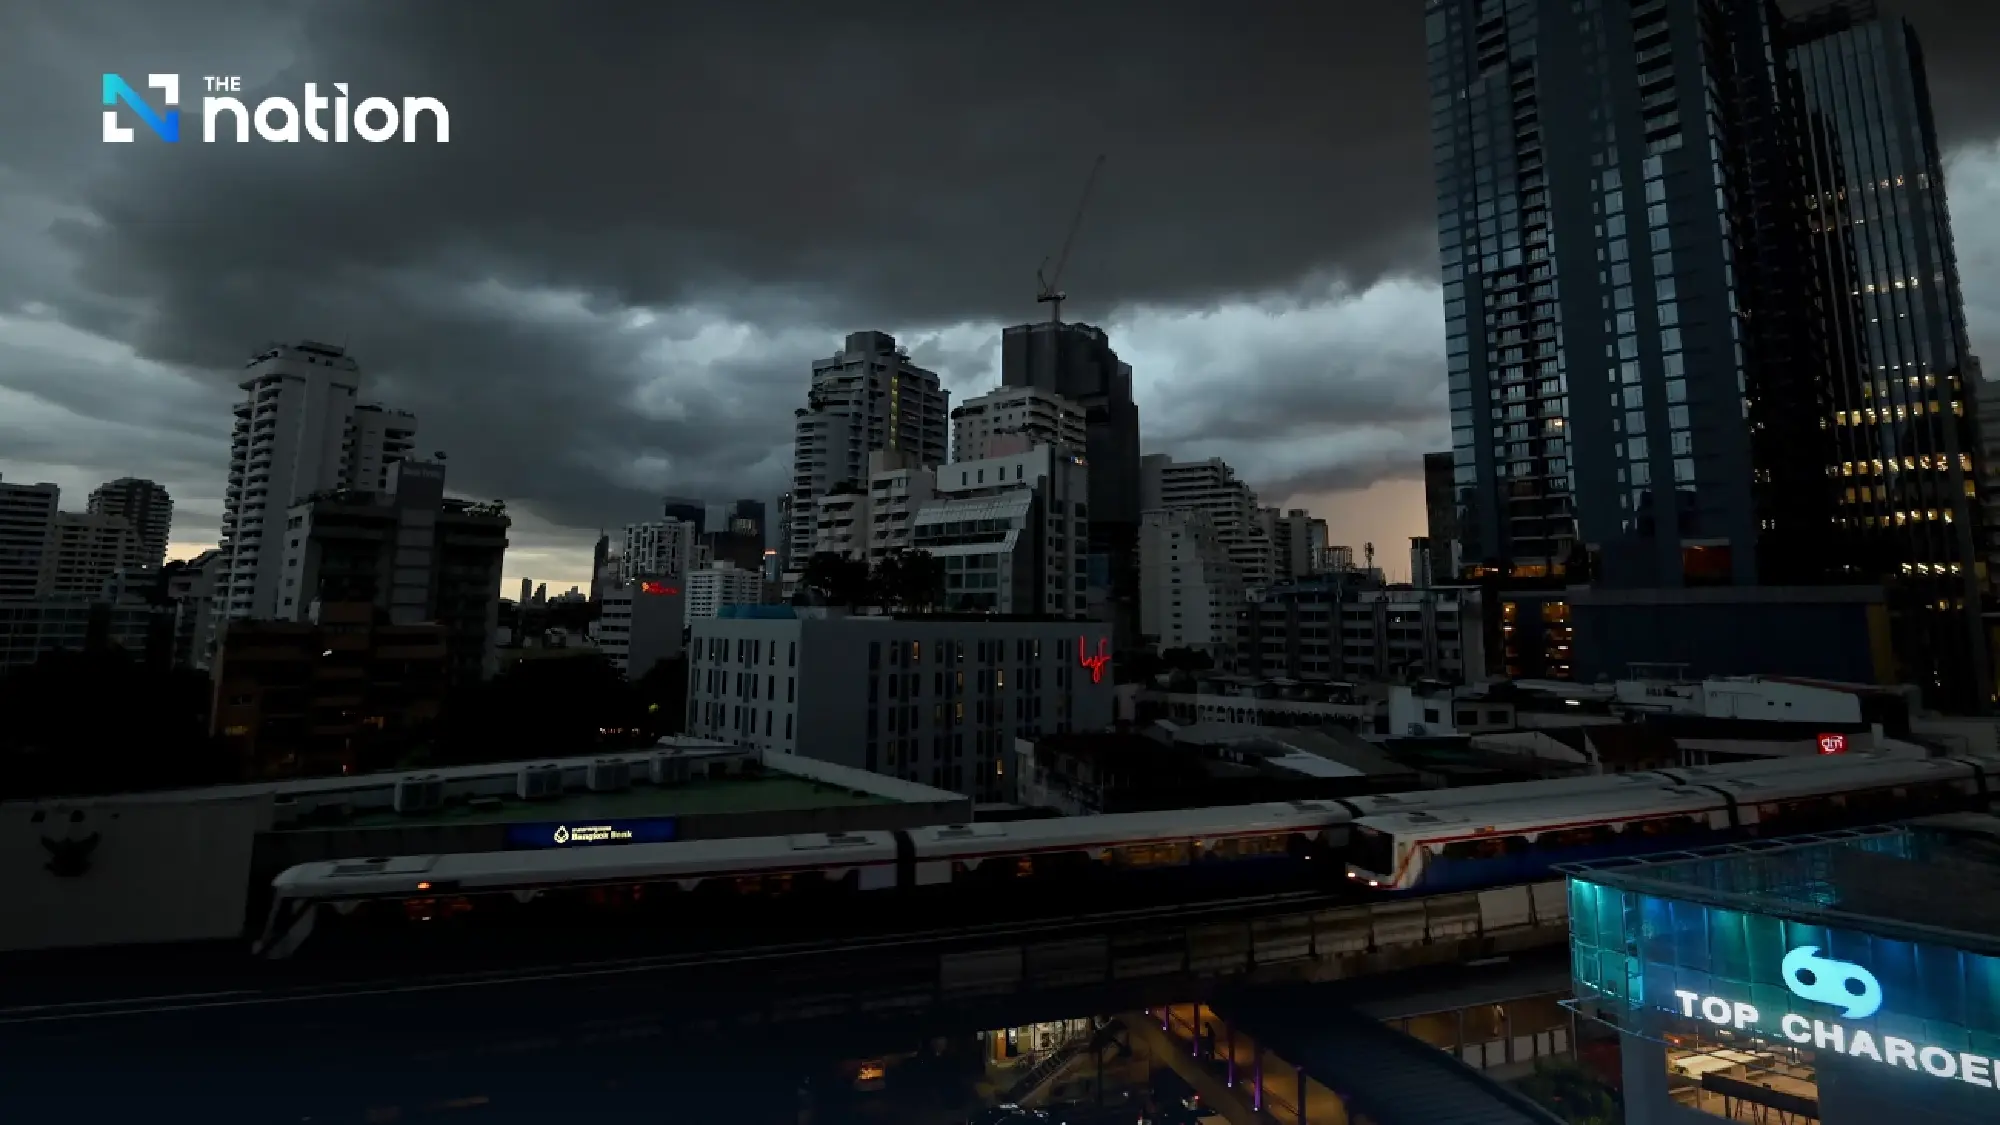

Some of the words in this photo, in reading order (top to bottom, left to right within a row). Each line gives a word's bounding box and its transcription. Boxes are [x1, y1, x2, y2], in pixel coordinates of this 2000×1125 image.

[610, 830, 632, 839] Bank
[1674, 989, 1759, 1029] TOP
[1781, 1012, 2000, 1091] CHAROE
